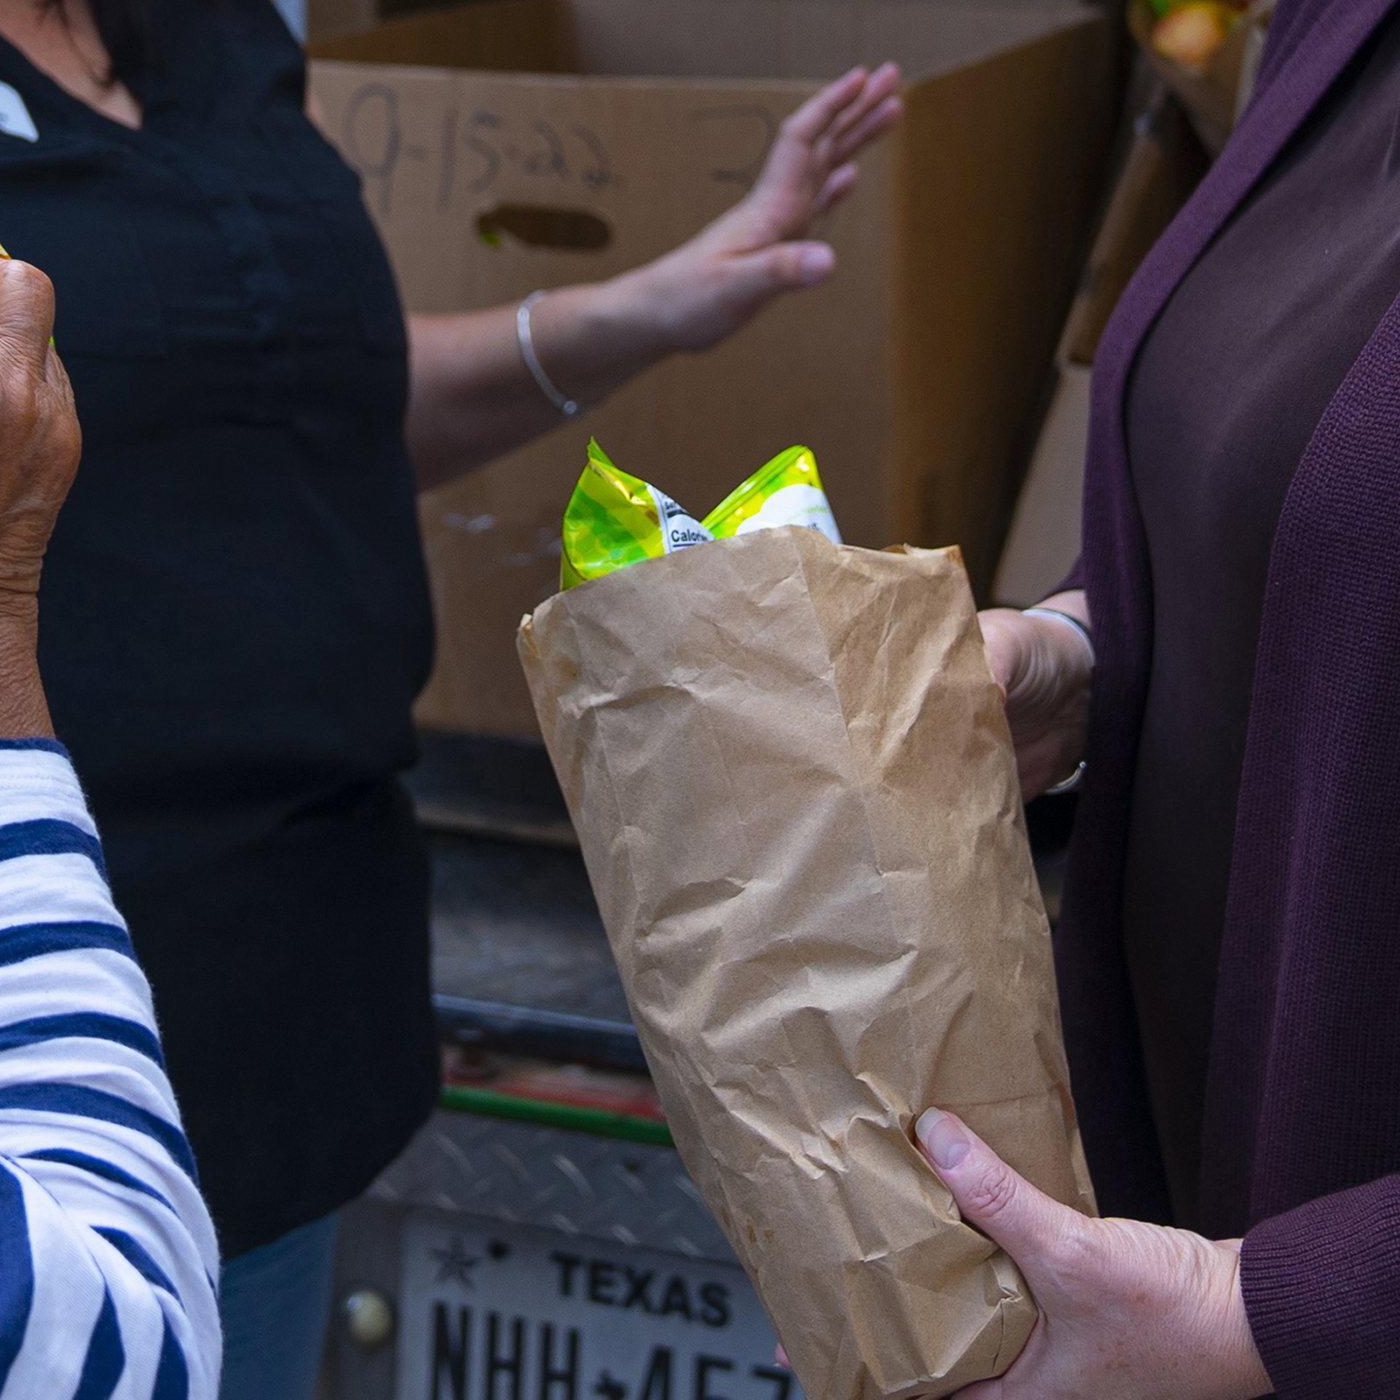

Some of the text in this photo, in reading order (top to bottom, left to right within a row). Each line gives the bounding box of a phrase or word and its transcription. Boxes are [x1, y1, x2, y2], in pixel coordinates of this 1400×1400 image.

[342, 82, 624, 214] 9-15-22
[552, 1250, 731, 1328] TEXAS
[432, 1302, 580, 1400] NHH
